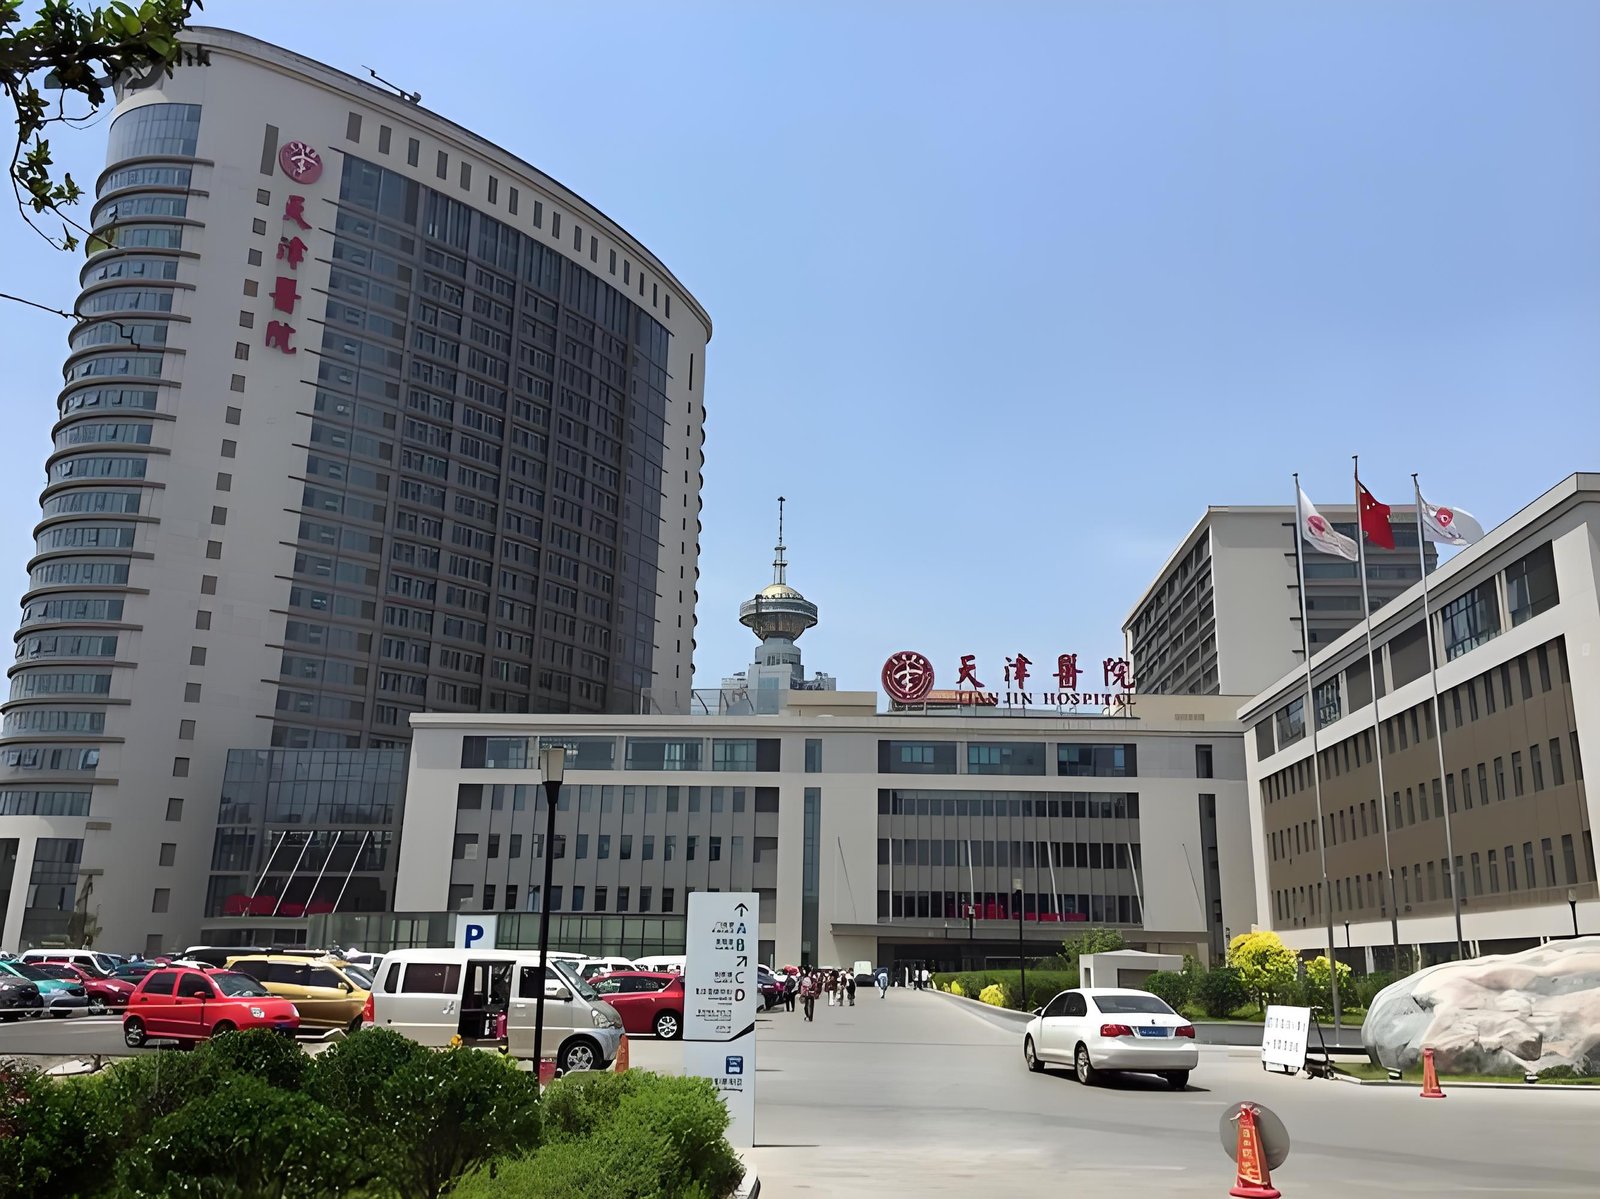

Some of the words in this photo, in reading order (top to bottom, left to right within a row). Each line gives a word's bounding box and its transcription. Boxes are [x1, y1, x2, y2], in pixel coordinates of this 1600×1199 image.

[1043, 692, 1136, 706] HOSPITAL
[736, 922, 747, 934] A
[464, 924, 484, 949] P
[735, 971, 745, 984] C
[734, 988, 746, 1002] D
